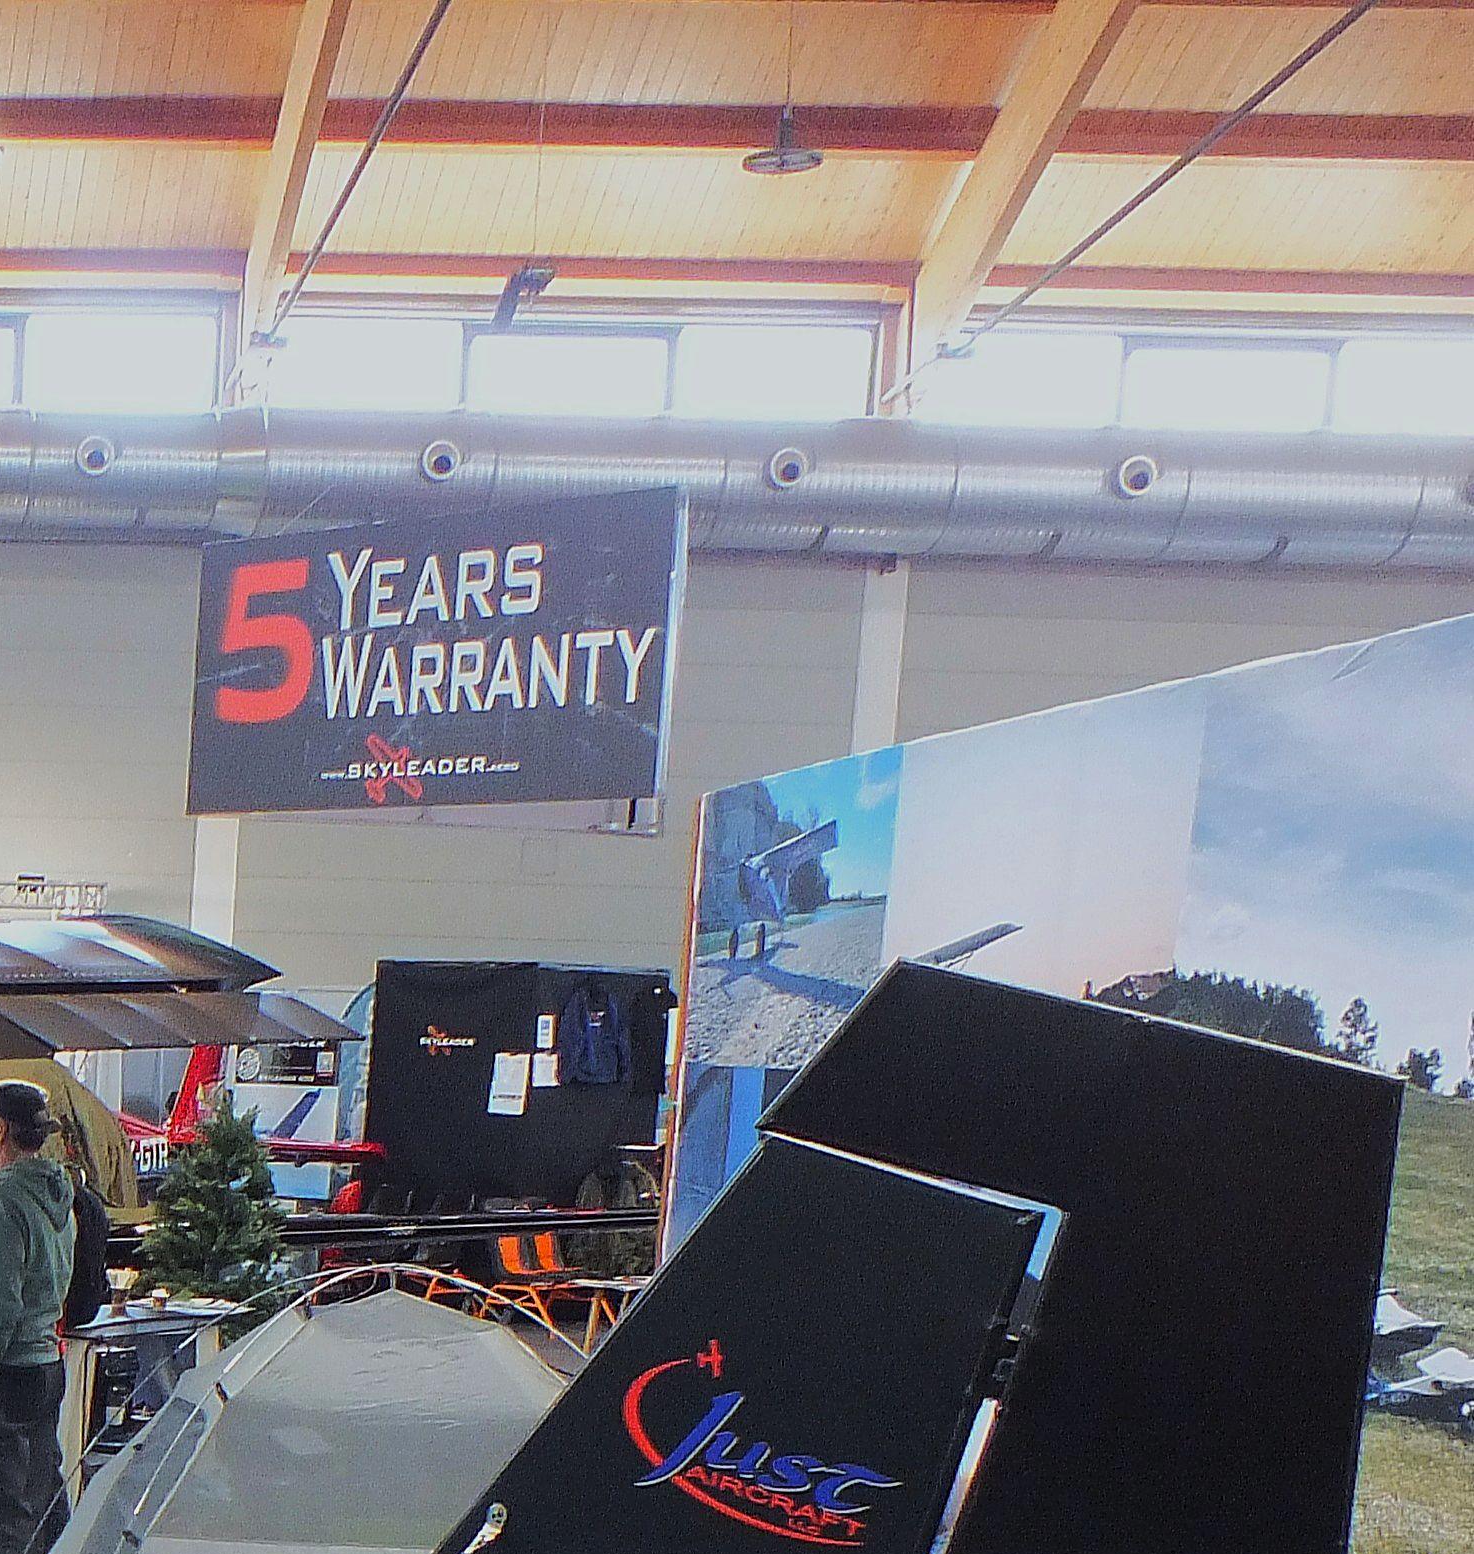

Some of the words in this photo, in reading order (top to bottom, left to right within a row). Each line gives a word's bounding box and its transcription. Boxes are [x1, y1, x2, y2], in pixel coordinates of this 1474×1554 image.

[326, 544, 545, 631] YEARS
[214, 557, 315, 725] 5
[320, 627, 657, 720] WARRANTY
